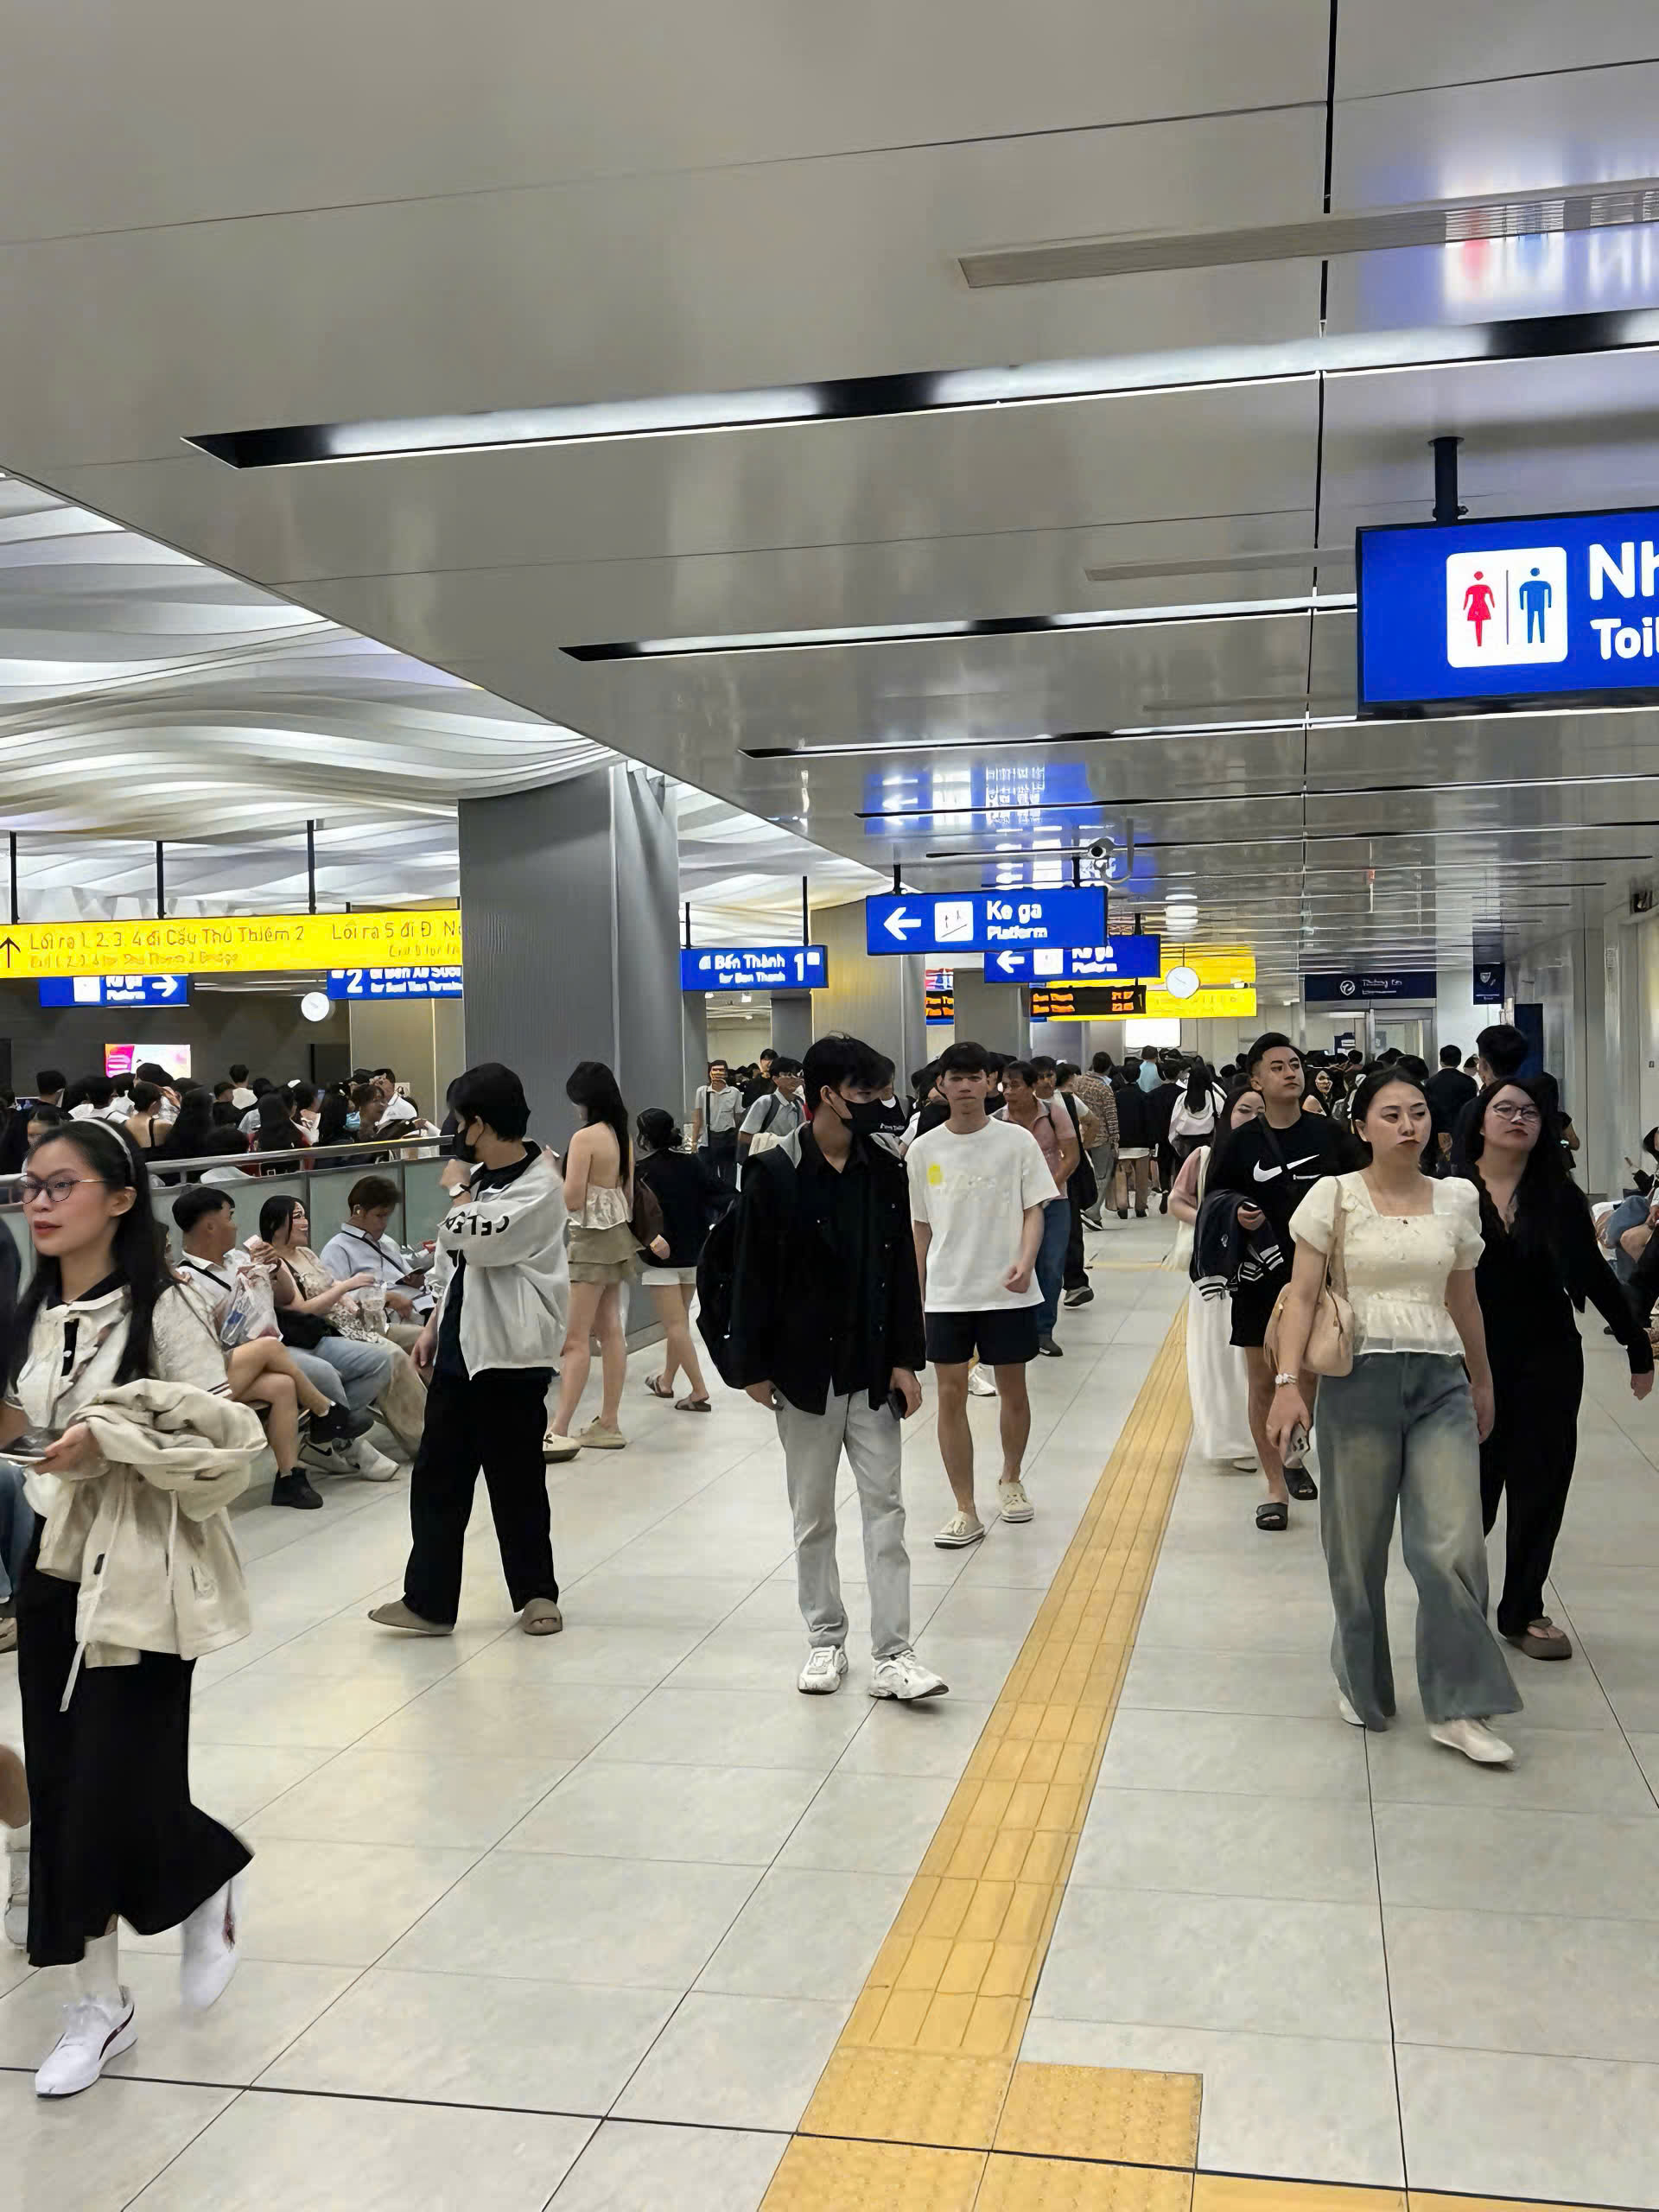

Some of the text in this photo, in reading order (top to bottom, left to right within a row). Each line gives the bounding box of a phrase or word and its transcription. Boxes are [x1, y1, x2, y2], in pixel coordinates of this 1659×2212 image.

[1018, 904, 1042, 924] ga
[296, 925, 304, 941] 2
[362, 927, 379, 939] ra
[794, 953, 804, 982] 1
[346, 969, 364, 994] 2
